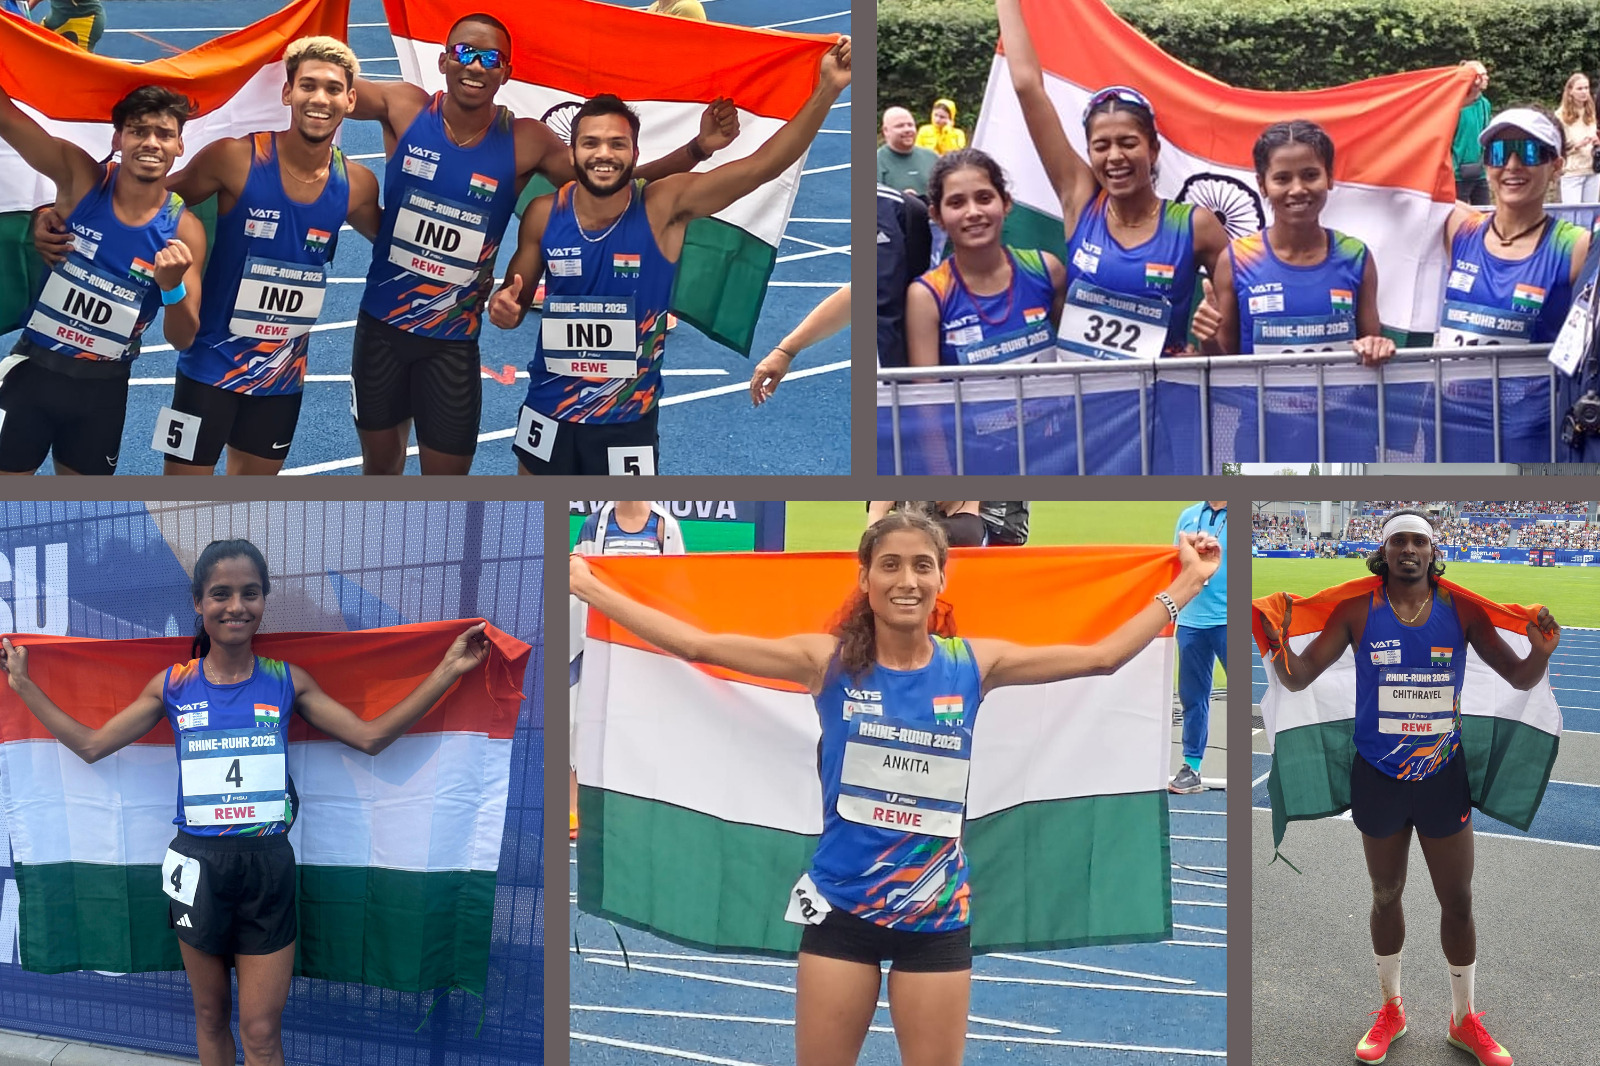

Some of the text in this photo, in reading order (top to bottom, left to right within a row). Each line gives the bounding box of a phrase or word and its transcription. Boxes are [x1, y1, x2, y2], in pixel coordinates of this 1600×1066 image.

[408, 144, 441, 162] VATS
[248, 208, 281, 220] VATS
[409, 194, 483, 226] RHINE-RUHR 2025
[72, 222, 104, 241] VATS
[414, 219, 462, 253] IND
[546, 246, 582, 257] VATS
[250, 264, 324, 282] RHINE-RUHR 2025
[411, 258, 446, 277] REWE
[613, 272, 640, 280] IND
[62, 261, 137, 302] RHINE-RUHR 2025
[1248, 282, 1284, 294] VATS
[62, 287, 113, 326] IND
[258, 286, 304, 313] IND
[550, 302, 627, 314] RHINE-RUHR 2025
[1075, 288, 1164, 319] RHINE-RUHR 2025
[254, 324, 290, 336] REWE
[1083, 314, 1142, 353] 322
[1262, 322, 1350, 338] RHINE-RUHR 2025
[1497, 319, 1525, 332] 2025
[56, 326, 96, 348] REWE
[566, 323, 613, 348] IND
[966, 337, 1028, 364] RHINE-RUHR
[571, 362, 608, 373] REWE
[166, 419, 184, 449] 5
[527, 419, 544, 448] 5
[623, 456, 641, 476] 5
[1369, 639, 1401, 649] VATS
[1386, 673, 1450, 682] RHINE-RUHR 2025
[844, 687, 882, 701] VATS
[176, 700, 209, 712] VATS
[858, 721, 962, 751] RHINE-RUHR 2025
[1401, 722, 1432, 732] REWE
[188, 735, 276, 752] RHINE-RUHR 2025
[225, 758, 244, 788] 4
[882, 754, 930, 774] ANKITA
[214, 806, 256, 820] REWE
[872, 806, 923, 827] REWE
[170, 864, 184, 894] 4
